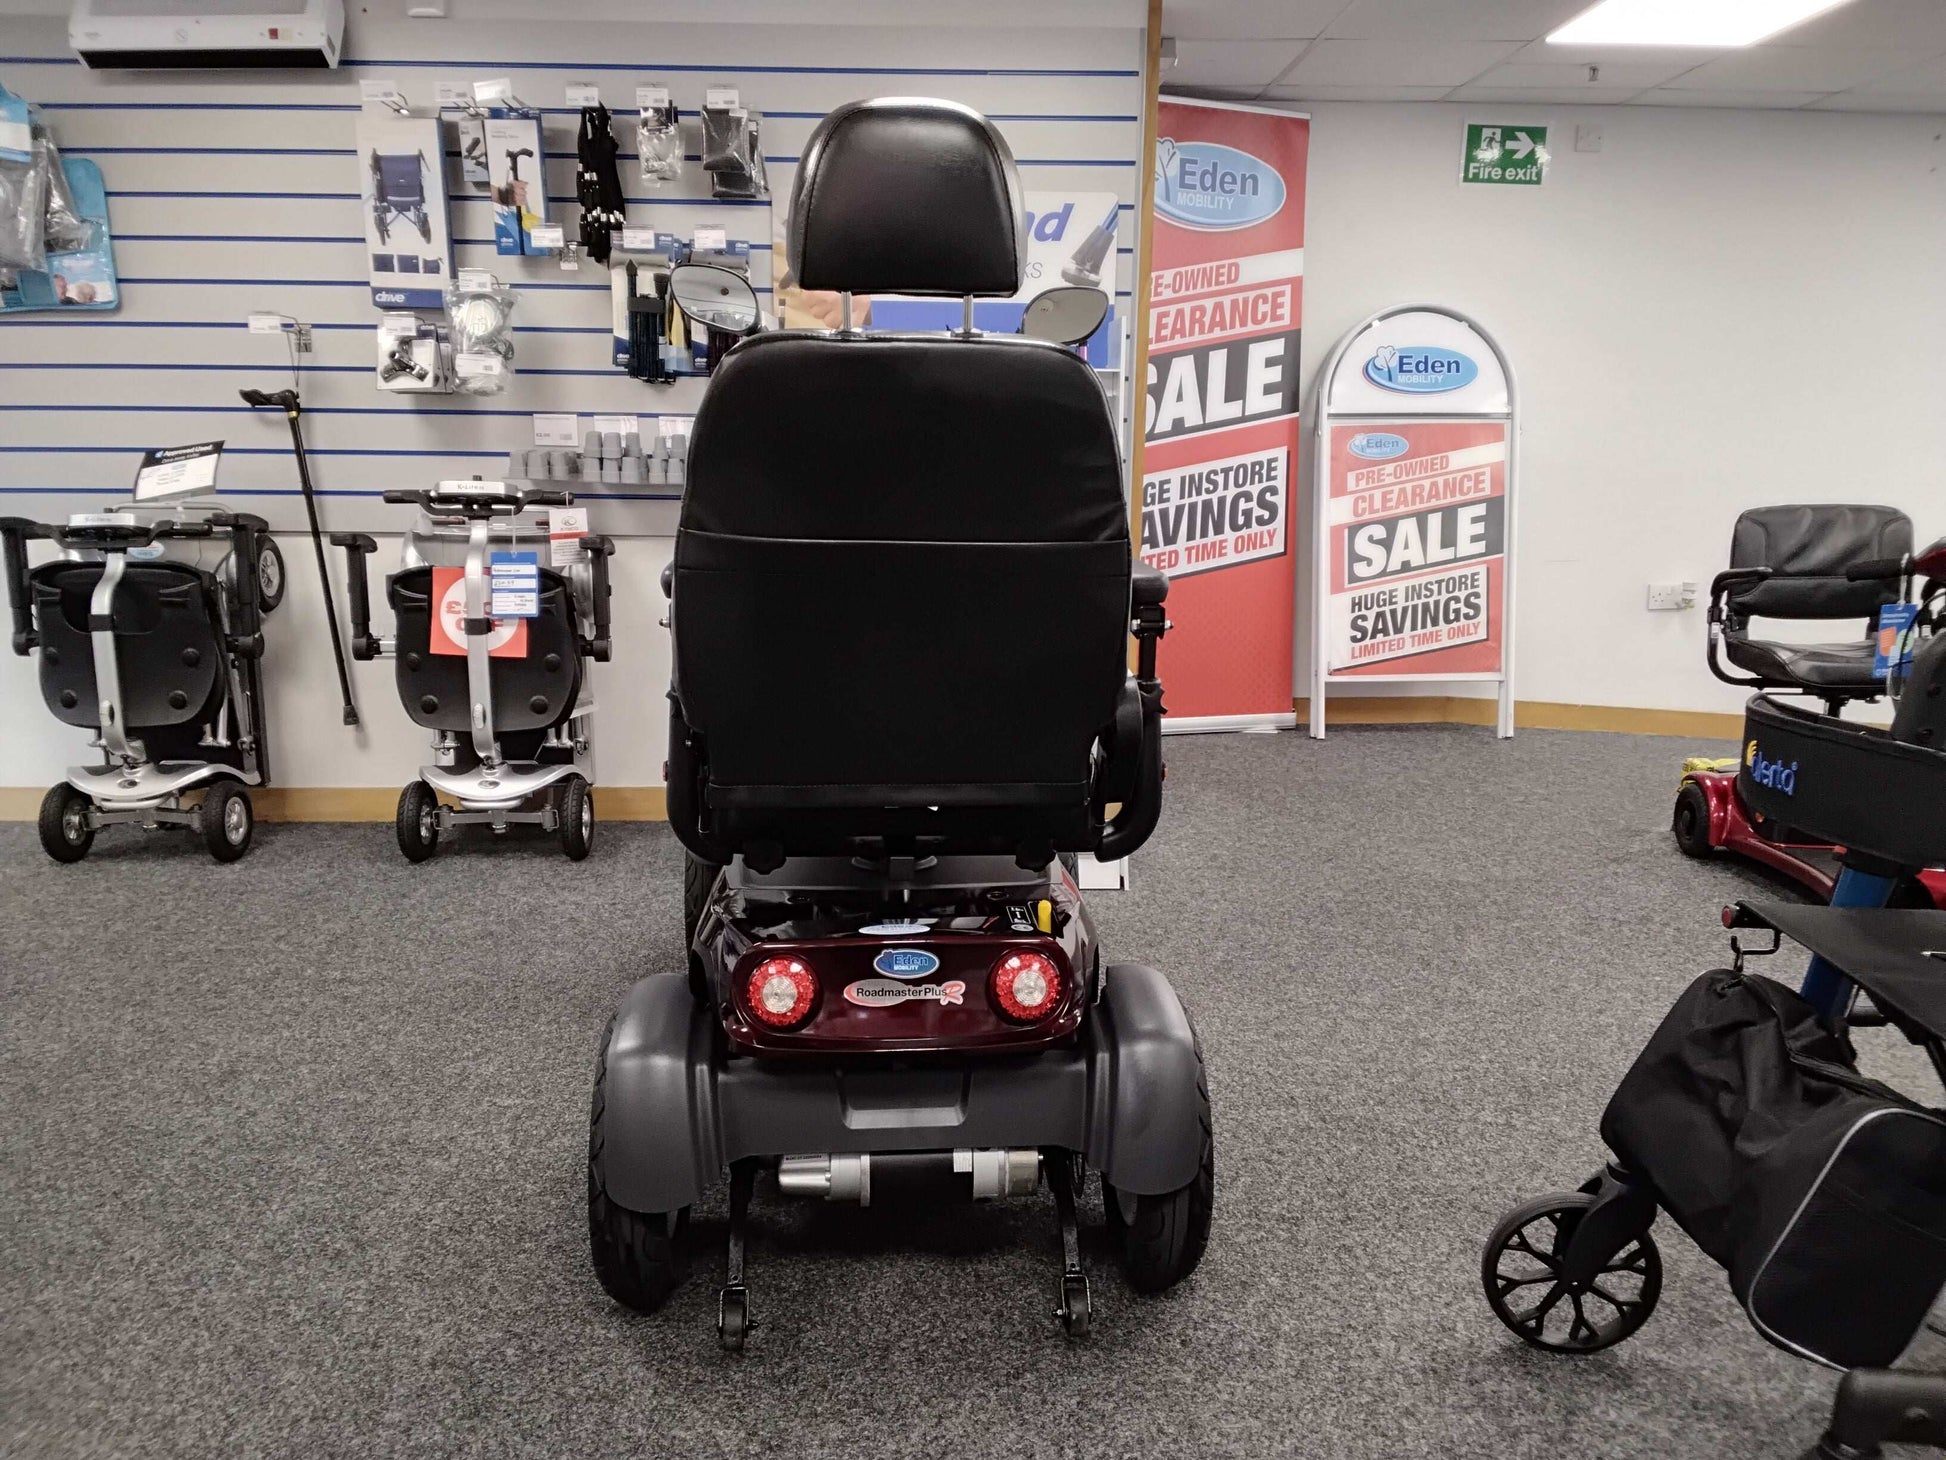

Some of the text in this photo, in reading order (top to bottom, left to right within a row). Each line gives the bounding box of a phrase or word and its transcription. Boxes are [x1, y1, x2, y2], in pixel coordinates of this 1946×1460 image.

[1179, 157, 1259, 196] Eden
[1468, 162, 1539, 181] Fire exit
[1176, 192, 1235, 210] MOBILITY
[375, 291, 406, 303] drive
[1151, 261, 1241, 298] E-OWNED
[1149, 290, 1286, 344] EARANCE
[1398, 355, 1461, 374] Eden
[1398, 374, 1444, 384] MOBILITY
[1145, 337, 1286, 435] ALE
[1366, 438, 1400, 449] Eden
[1179, 456, 1280, 500] INSTORE
[1354, 455, 1450, 488] PRE-OWNED
[1352, 471, 1487, 518] CLEARANCE
[1141, 484, 1280, 550] AVINGS
[1184, 538, 1229, 565] TIME
[1233, 527, 1278, 554] ONLY
[1353, 503, 1487, 578] SALE
[1350, 571, 1481, 614] HUGE INSTORE
[1349, 591, 1482, 644] SAVINGS
[1350, 621, 1481, 660] LIMITED TIME ONLY
[893, 955, 928, 966] Eden
